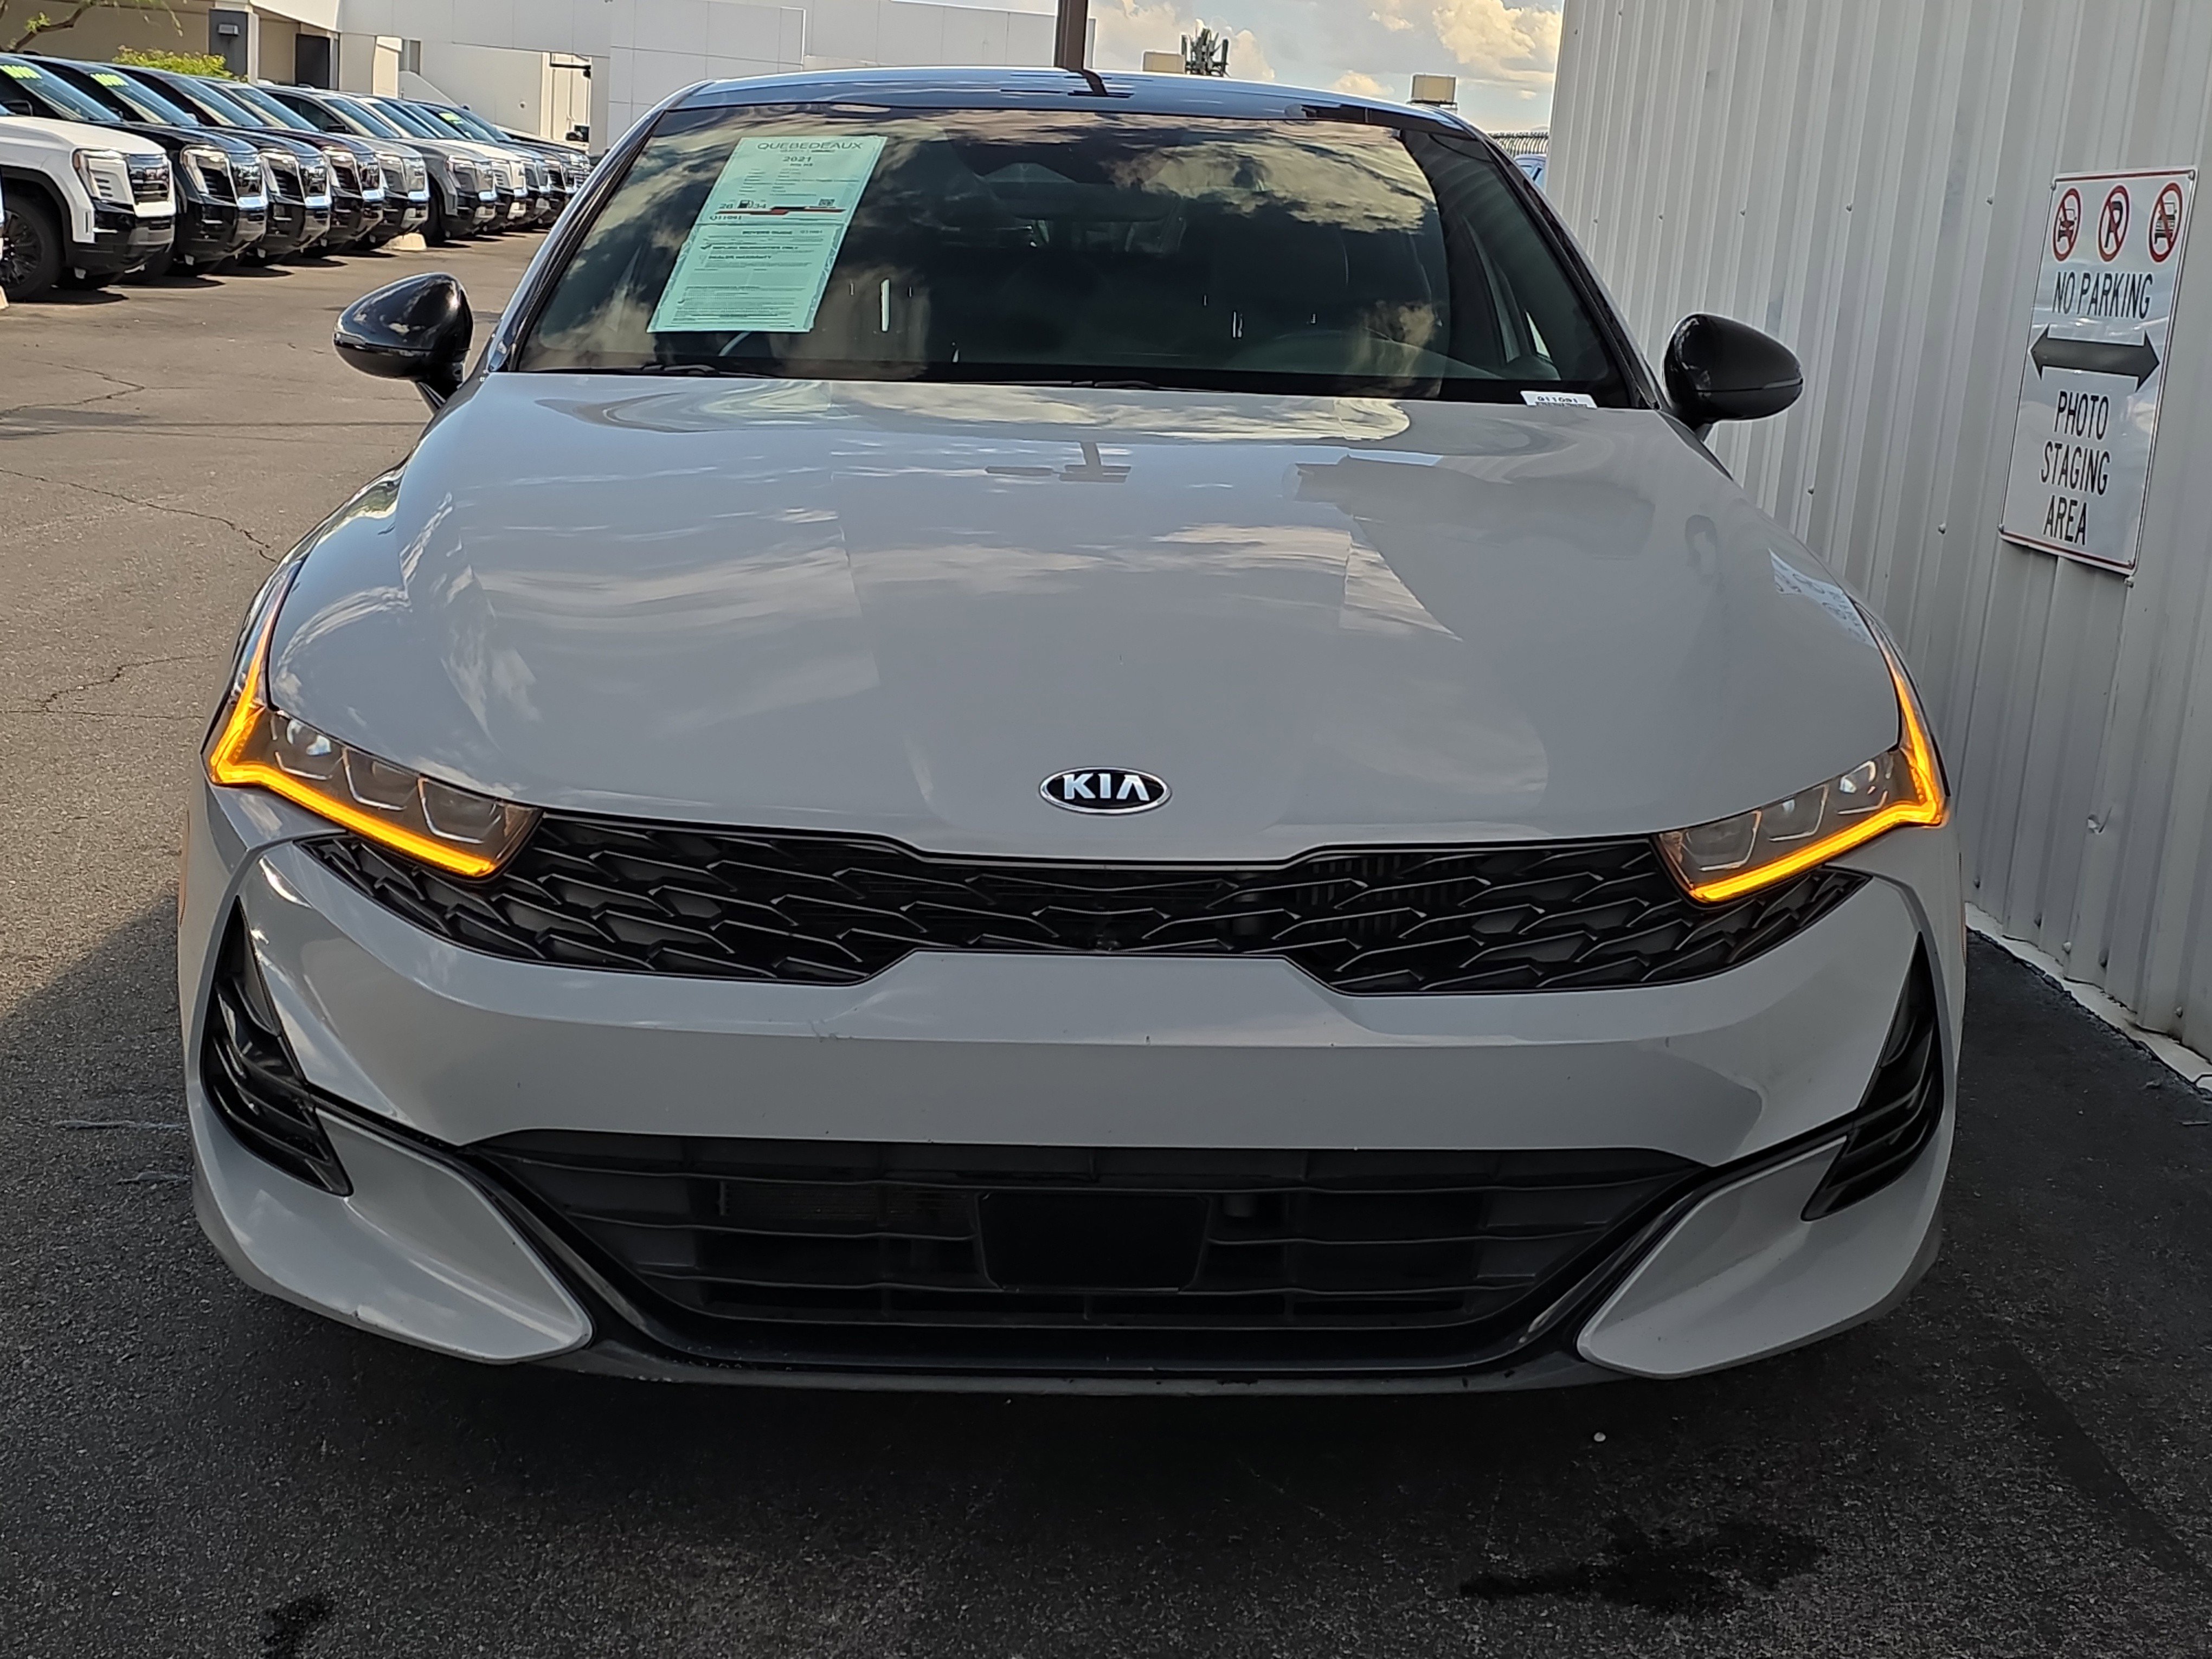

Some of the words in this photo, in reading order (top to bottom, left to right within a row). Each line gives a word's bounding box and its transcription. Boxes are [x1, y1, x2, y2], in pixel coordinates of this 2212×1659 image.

[757, 142, 863, 150] QUEBEDEAUX
[2052, 271, 2075, 314] NO
[2077, 272, 2153, 319] PARKING
[2054, 390, 2109, 440] PHOTO
[2041, 441, 2110, 496] STAGING
[2043, 494, 2087, 545] AREA
[1062, 773, 1150, 801] KIA
